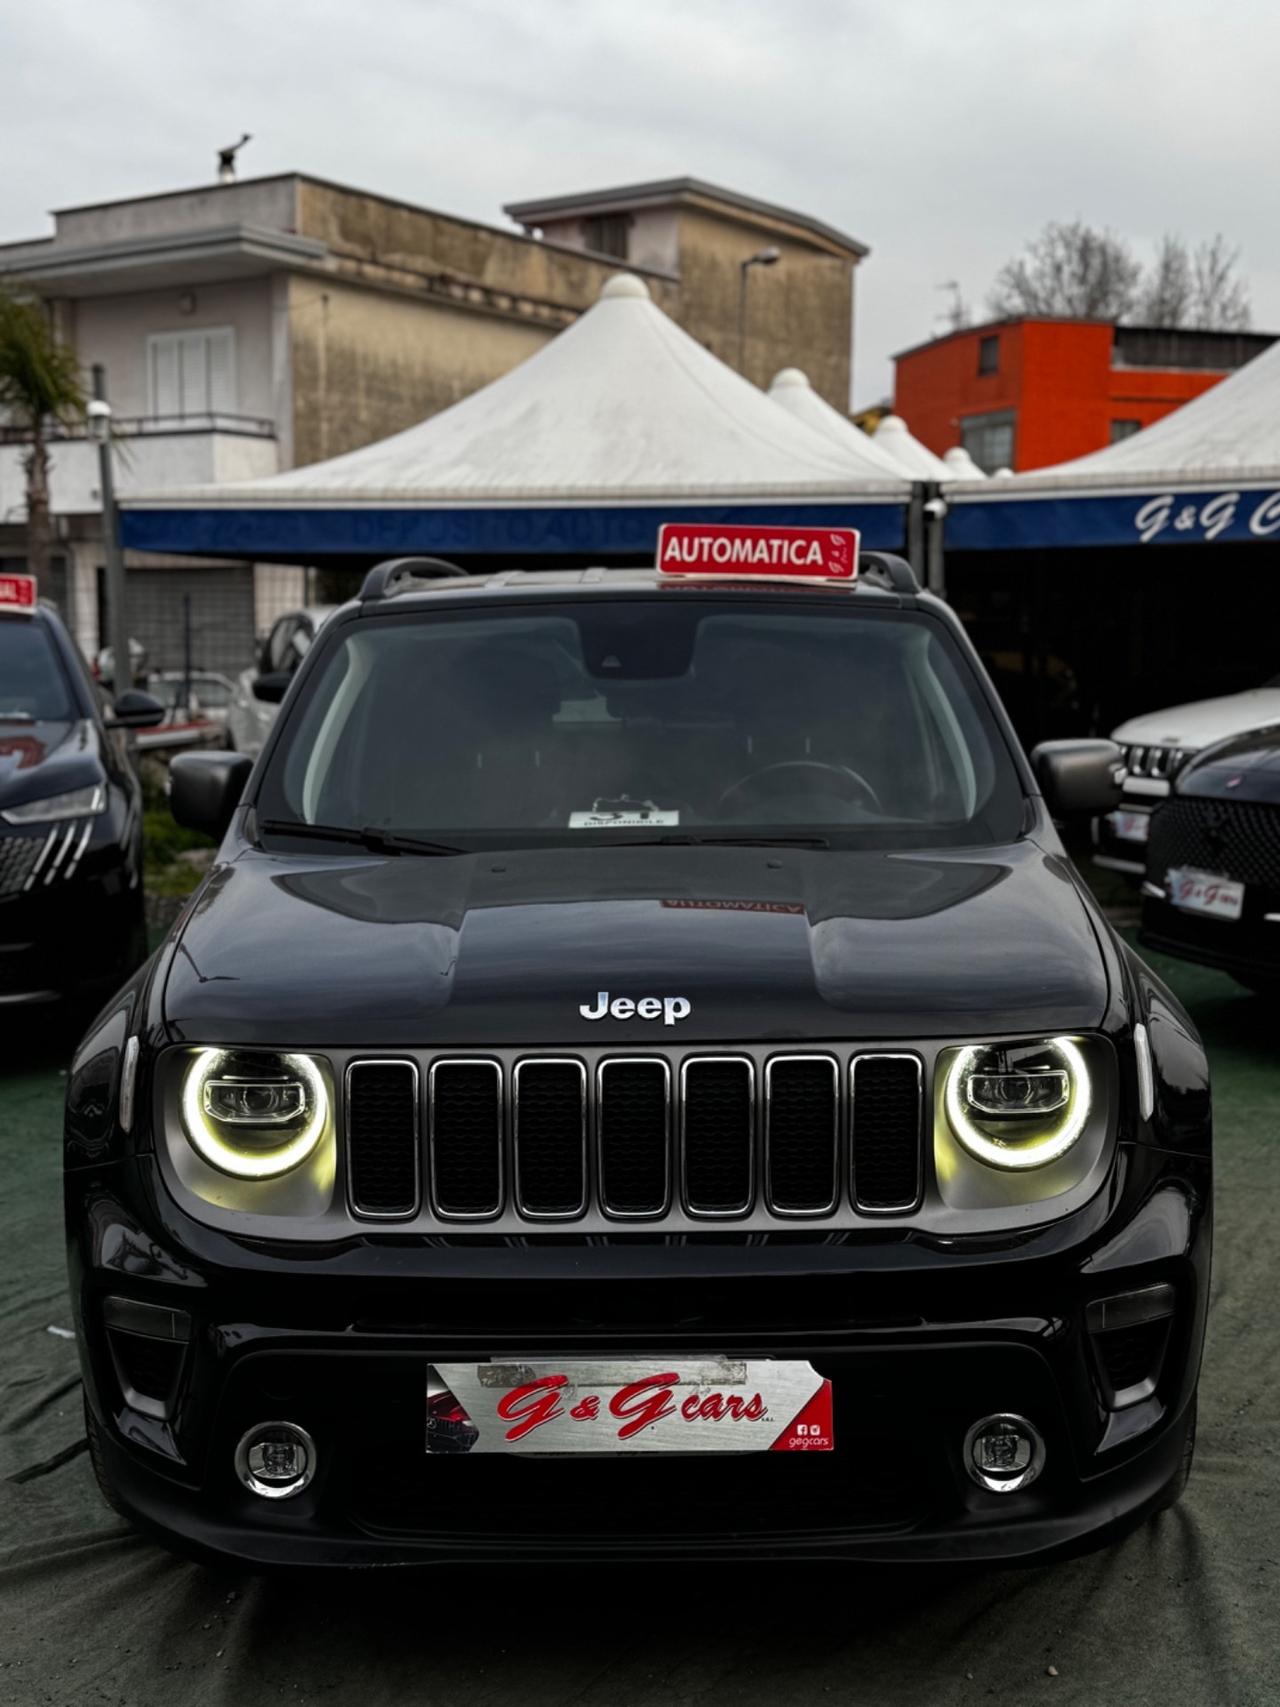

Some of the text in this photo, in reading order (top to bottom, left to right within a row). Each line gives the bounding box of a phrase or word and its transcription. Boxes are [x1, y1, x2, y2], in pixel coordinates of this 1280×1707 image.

[663, 536, 823, 566] AUTOMATICA
[579, 991, 691, 1025] Jeep
[681, 1392, 768, 1422] cars
[788, 1437, 829, 1449] gegcars
